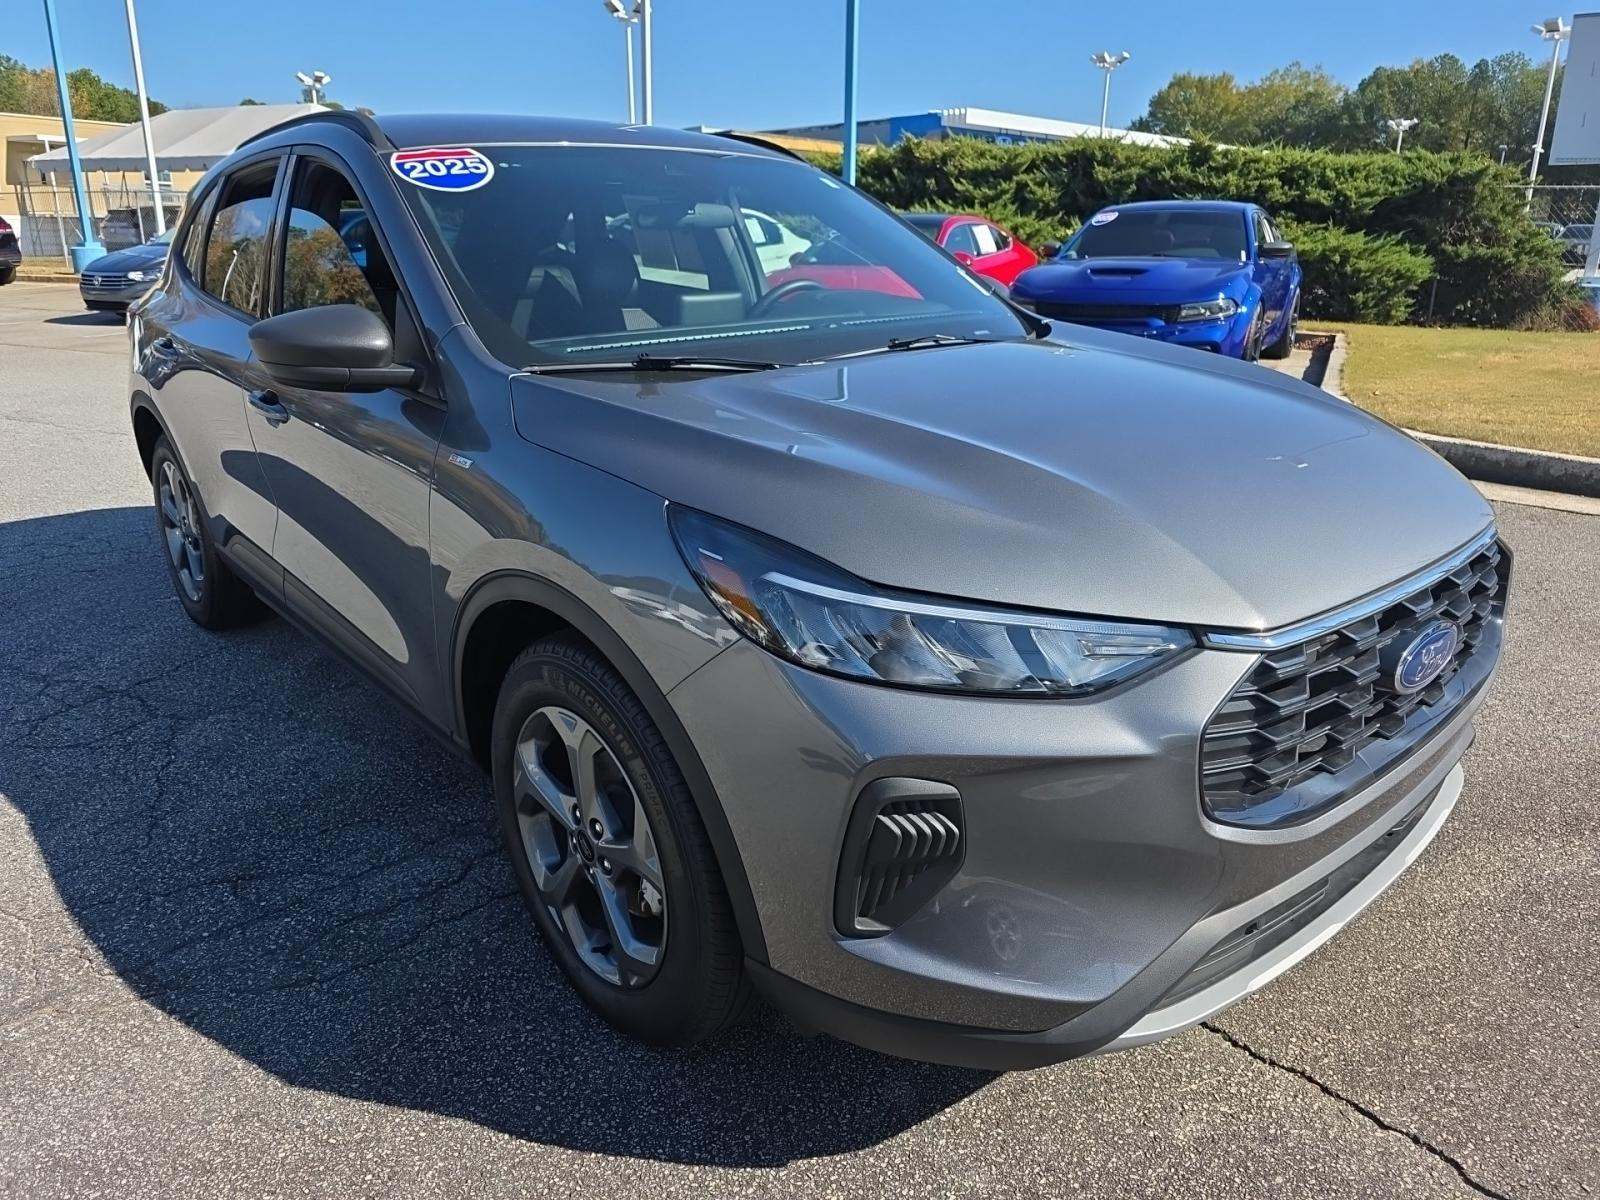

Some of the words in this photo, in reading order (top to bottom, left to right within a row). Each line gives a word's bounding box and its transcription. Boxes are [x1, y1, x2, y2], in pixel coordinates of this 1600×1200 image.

[404, 159, 487, 178] 2025
[567, 680, 633, 756] MICHELIN
[639, 771, 671, 835] PRIMAC
